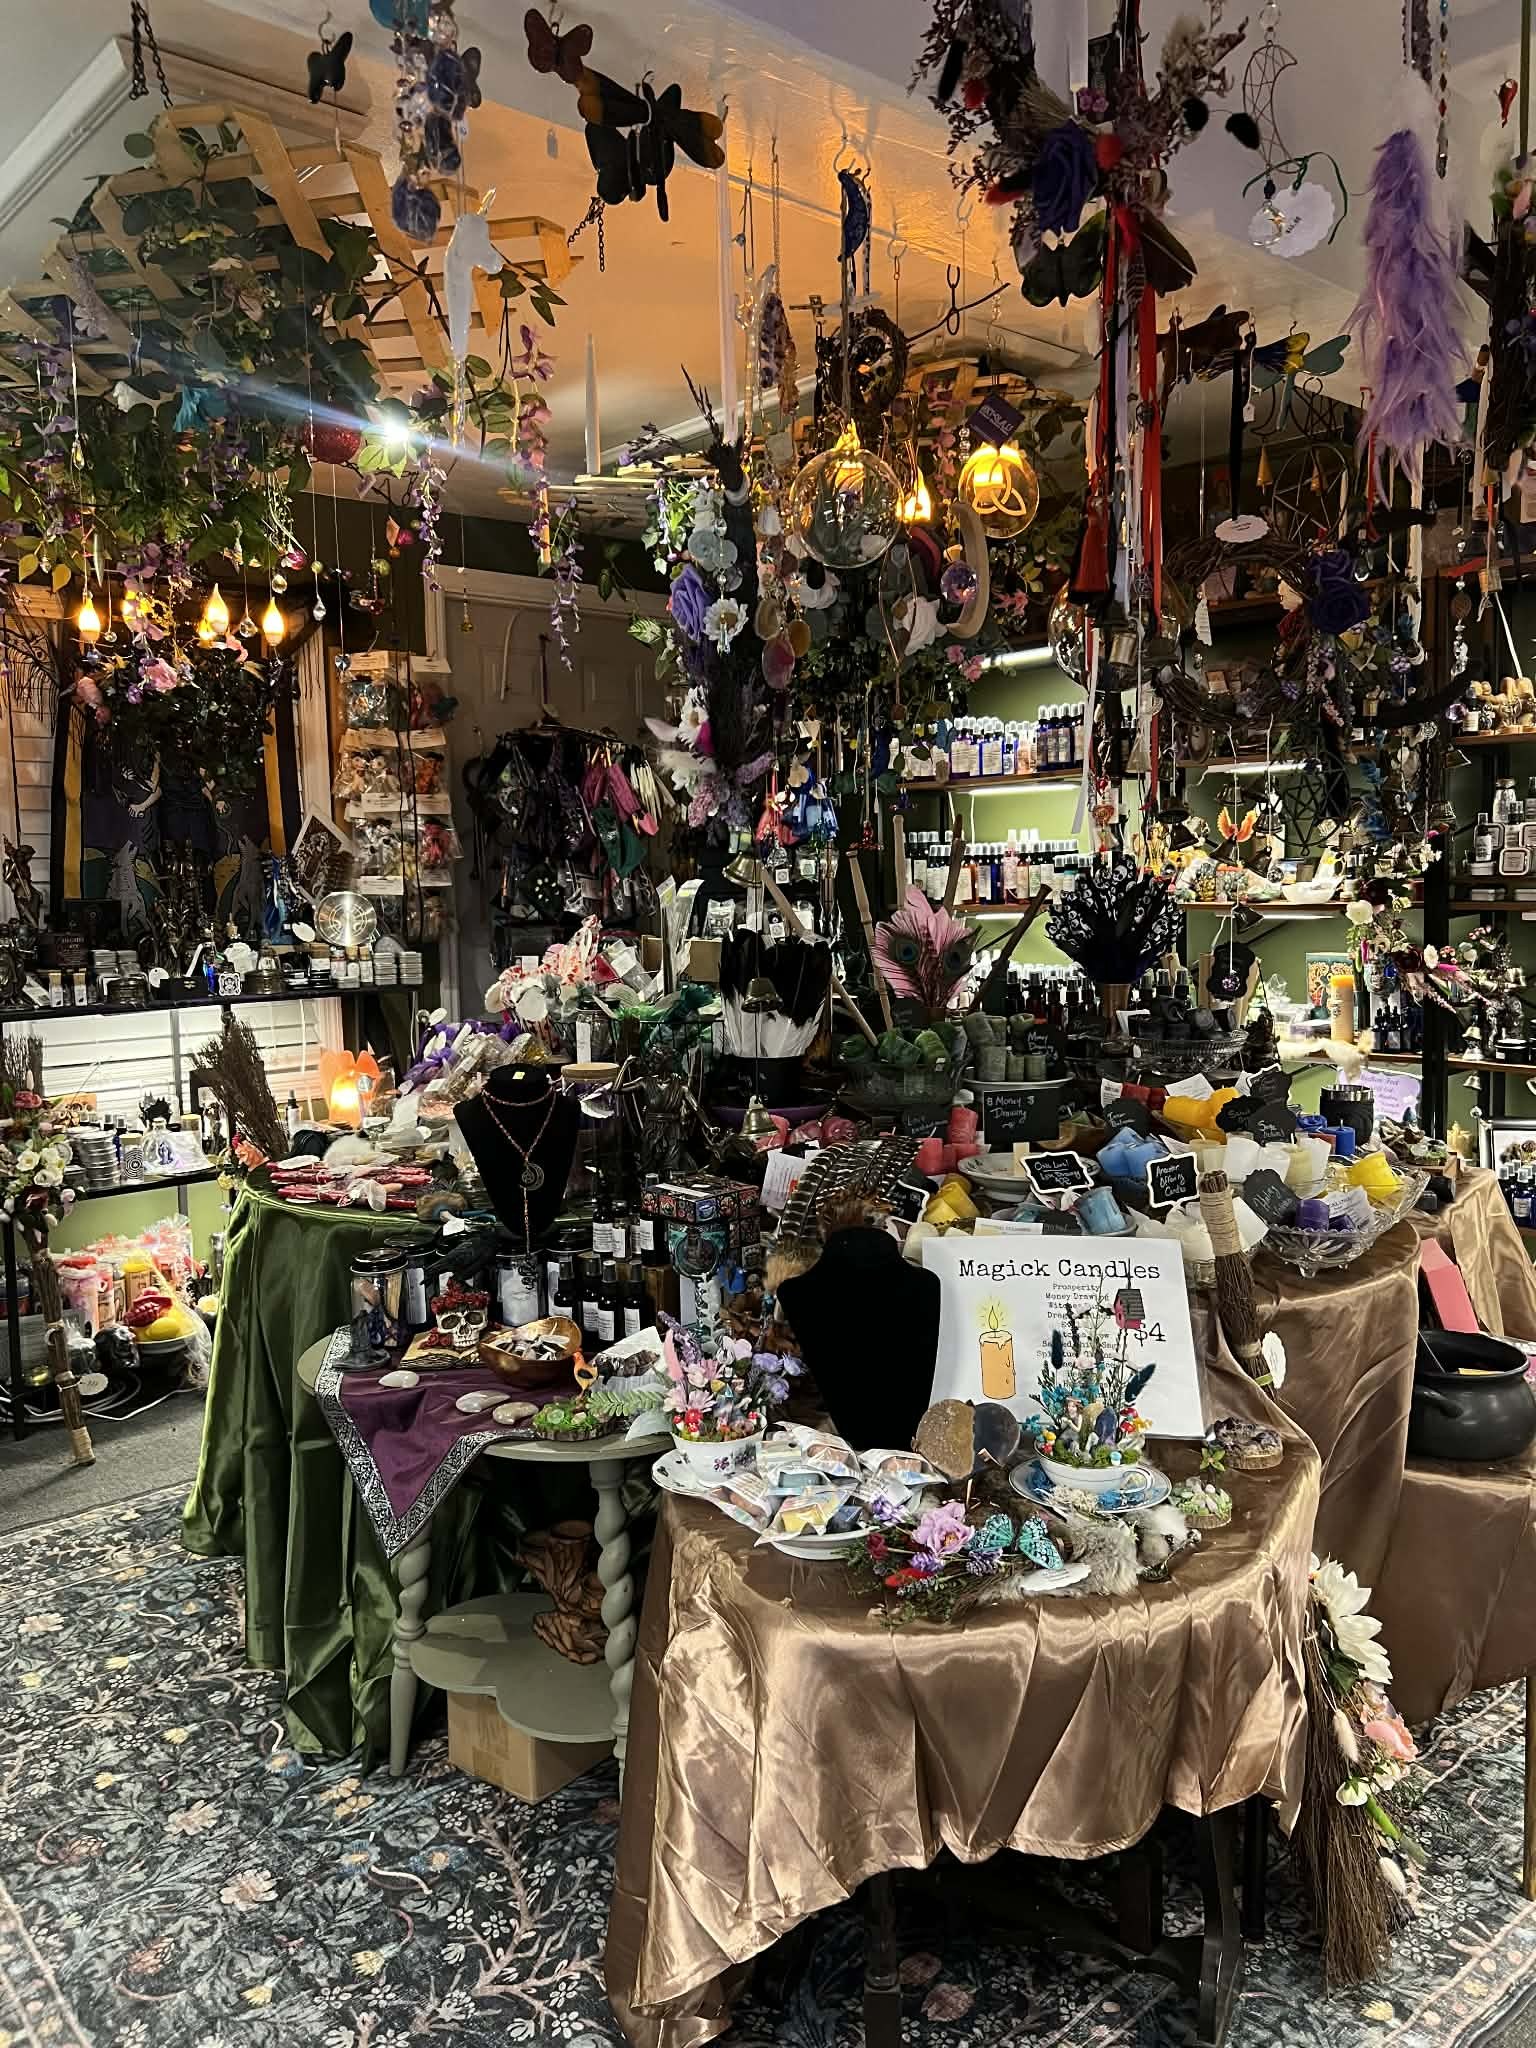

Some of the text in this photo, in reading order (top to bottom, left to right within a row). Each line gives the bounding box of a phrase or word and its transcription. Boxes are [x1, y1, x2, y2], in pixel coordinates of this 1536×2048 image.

[995, 1096, 1022, 1108] Money
[959, 1259, 1161, 1281] Magick Candles
[1053, 1283, 1100, 1293] Prosperity
[1046, 1292, 1071, 1301] Money
[1134, 1322, 1167, 1346] $4
